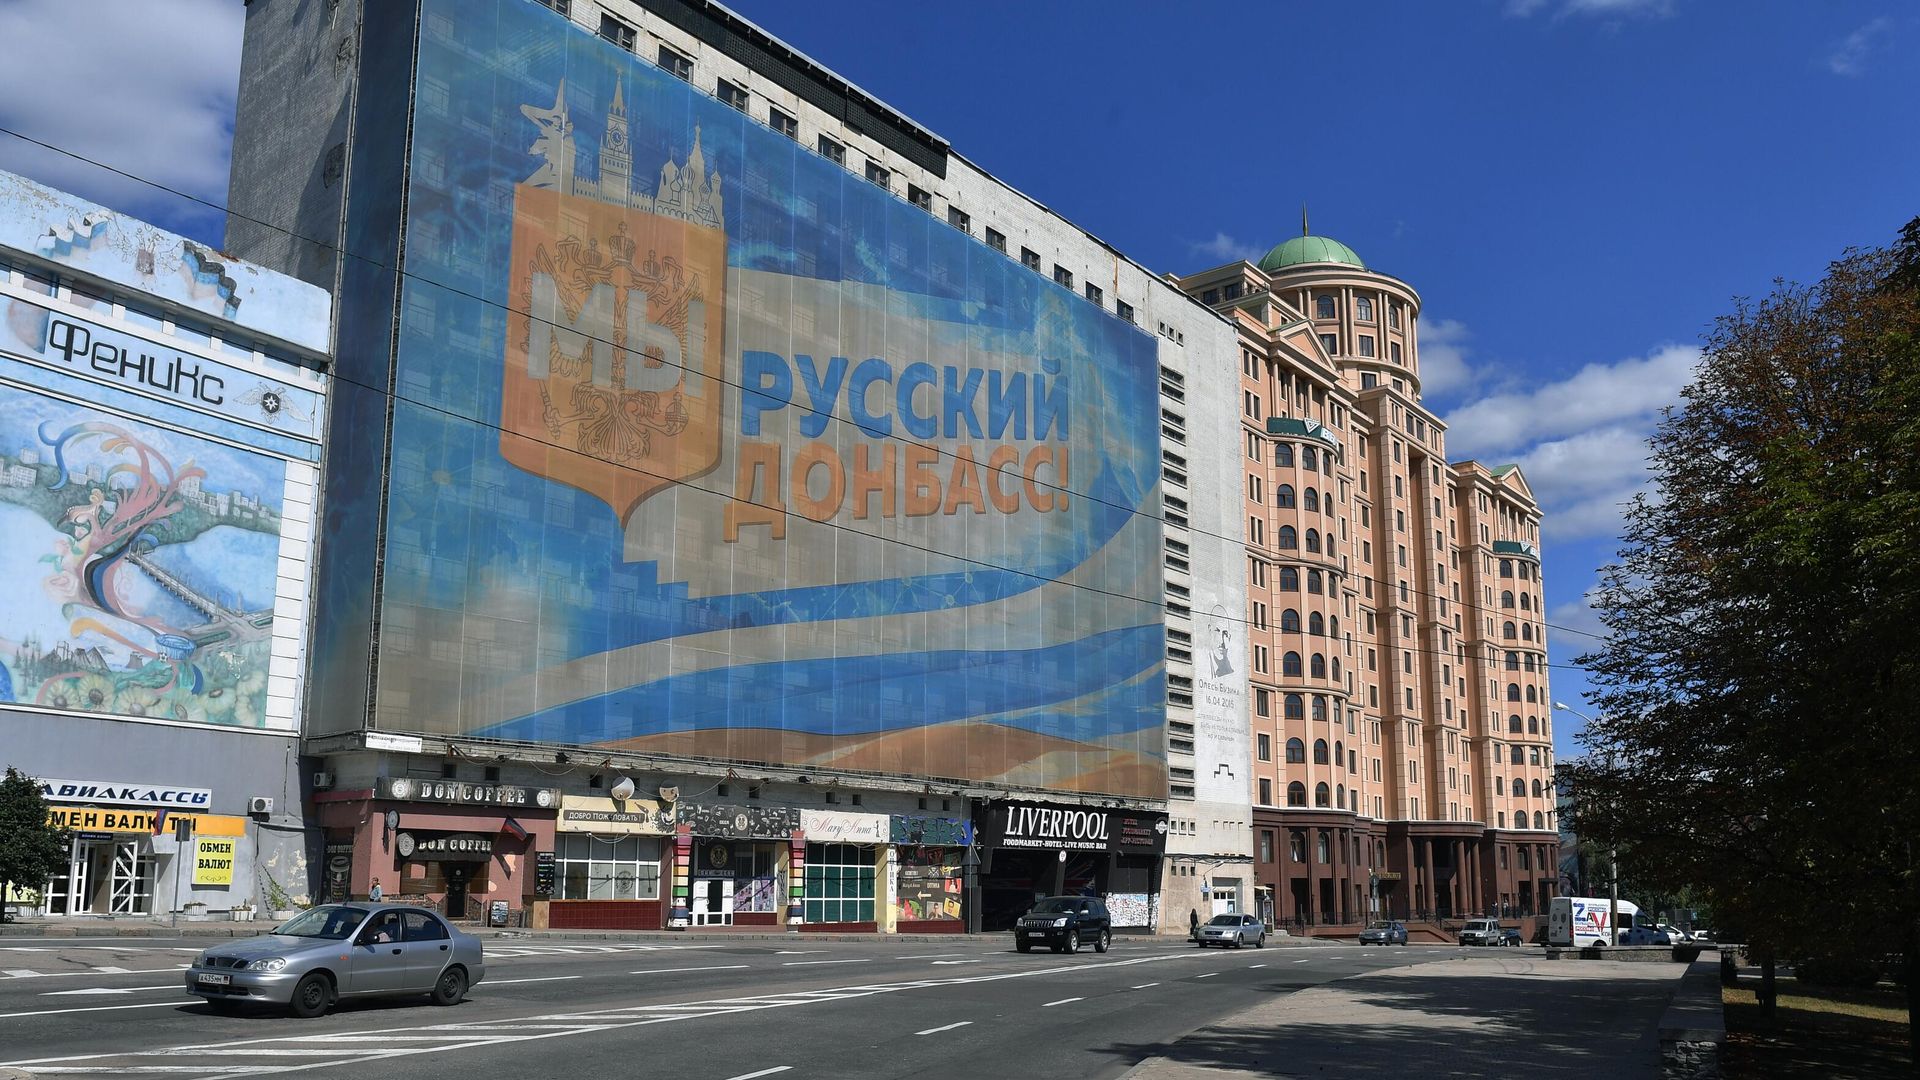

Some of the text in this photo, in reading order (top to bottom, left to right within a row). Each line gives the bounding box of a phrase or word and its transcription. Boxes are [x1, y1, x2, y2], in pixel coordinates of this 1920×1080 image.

[527, 272, 705, 398] МЫ
[49, 319, 225, 406] Феникс
[741, 350, 1070, 441] РУССКИЙ
[723, 441, 1070, 543] ДОНБАСС!
[42, 783, 208, 804] АВИАКАССЫ
[421, 782, 525, 804] DON COFFEE
[568, 812, 591, 820] ДОБРО
[1005, 806, 1109, 840] LIVERPOOL
[200, 842, 231, 853] ОБМЕН
[450, 839, 492, 851] COFFEE
[1078, 841, 1095, 849] MUSIC
[198, 859, 232, 869] ВАЛЮТ
